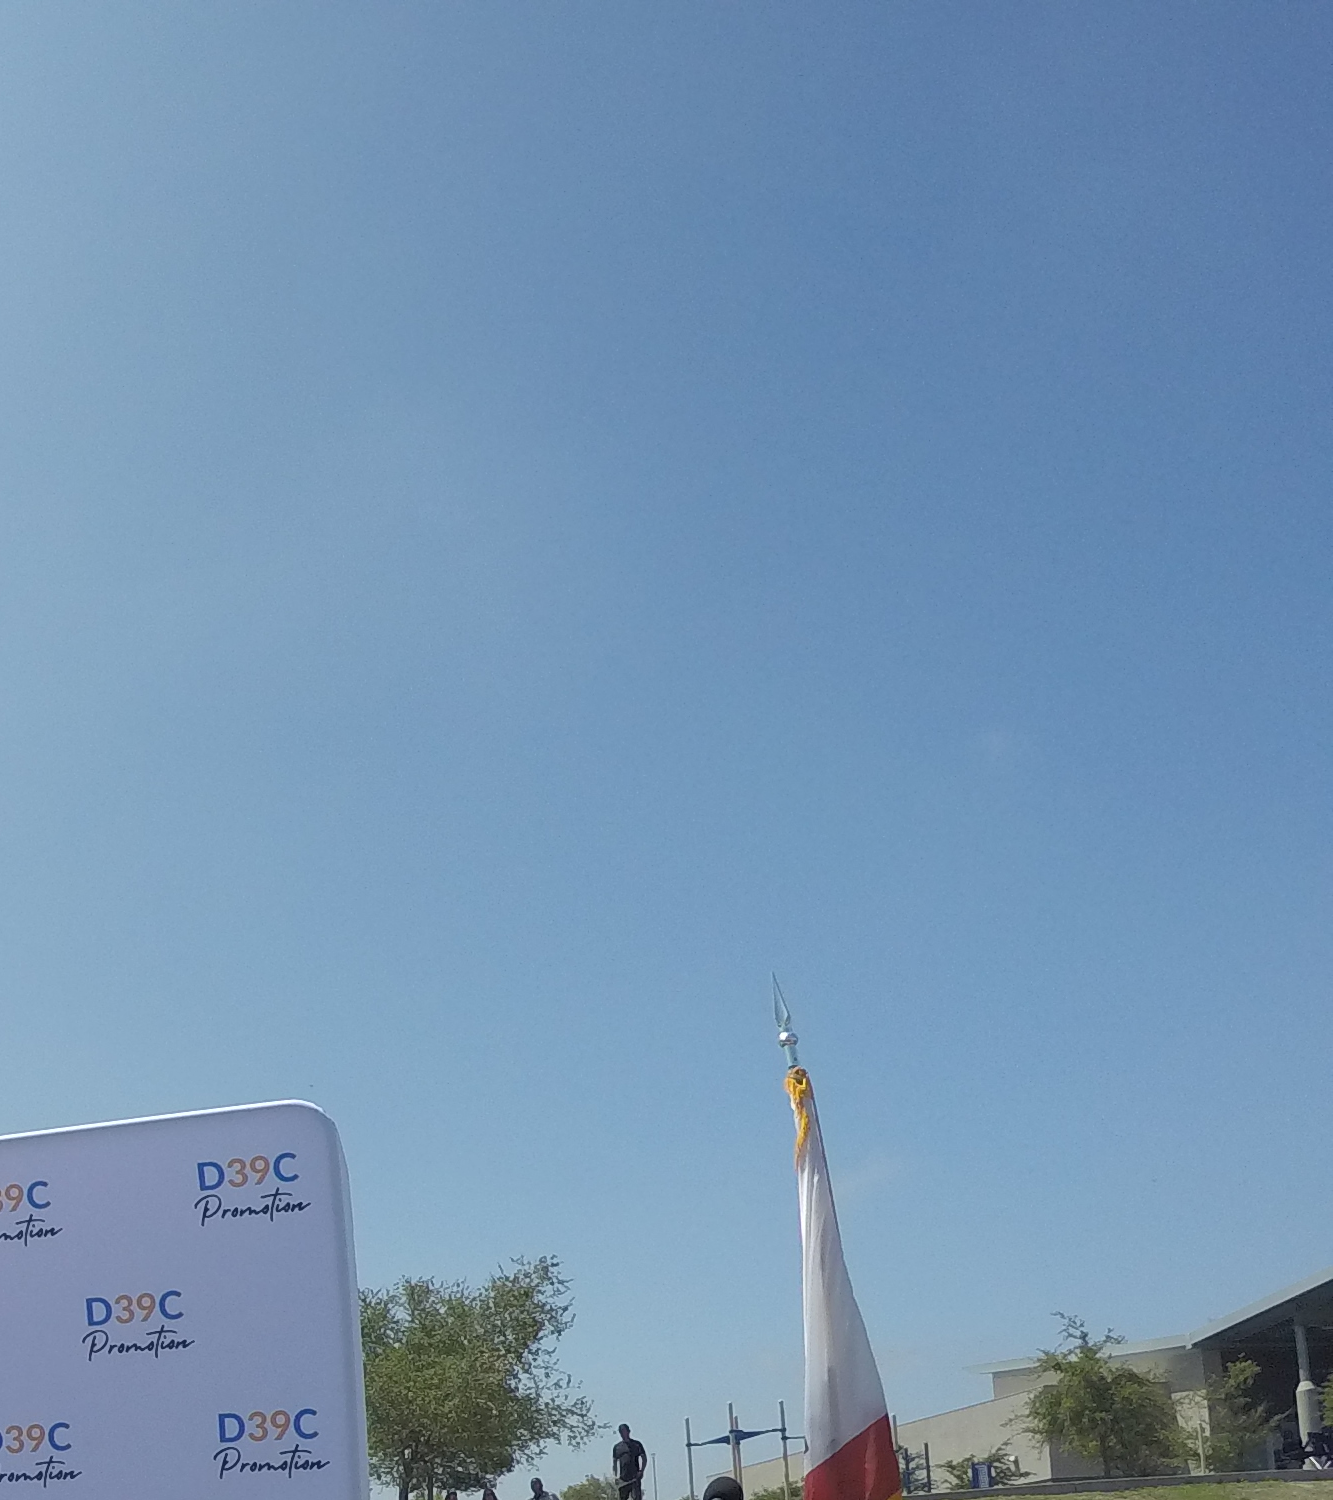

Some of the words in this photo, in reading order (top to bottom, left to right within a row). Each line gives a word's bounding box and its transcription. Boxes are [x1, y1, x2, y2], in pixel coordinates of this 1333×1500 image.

[197, 1152, 299, 1191] D39C
[194, 1187, 311, 1227] Promotion
[86, 1290, 184, 1326] D39C
[82, 1325, 195, 1361] Promotion
[218, 1409, 319, 1443] D39C
[213, 1444, 330, 1479] Promotion
